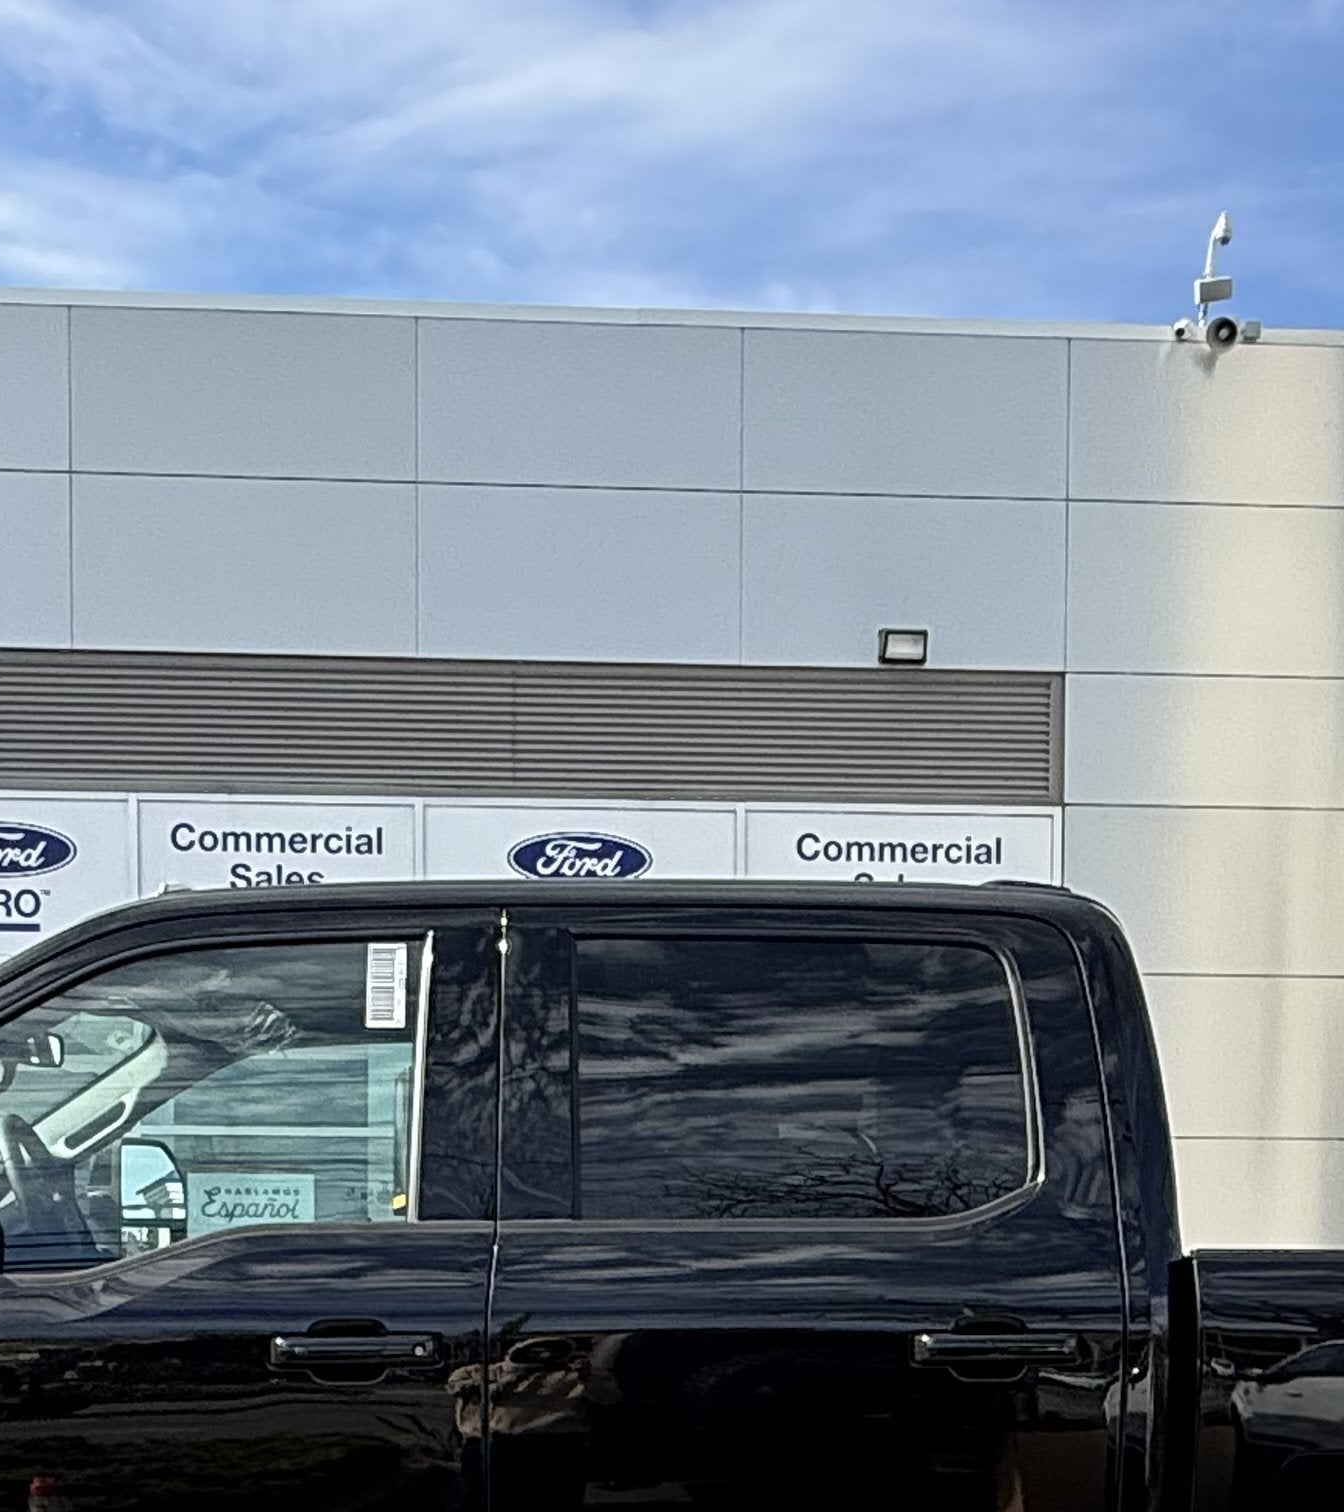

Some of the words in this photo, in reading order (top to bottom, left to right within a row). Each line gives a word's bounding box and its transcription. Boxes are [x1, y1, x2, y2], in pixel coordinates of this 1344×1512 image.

[170, 822, 383, 855] Commercial
[796, 832, 1002, 865] Commercial
[536, 839, 624, 877] Ford
[201, 1186, 301, 1223] Español
